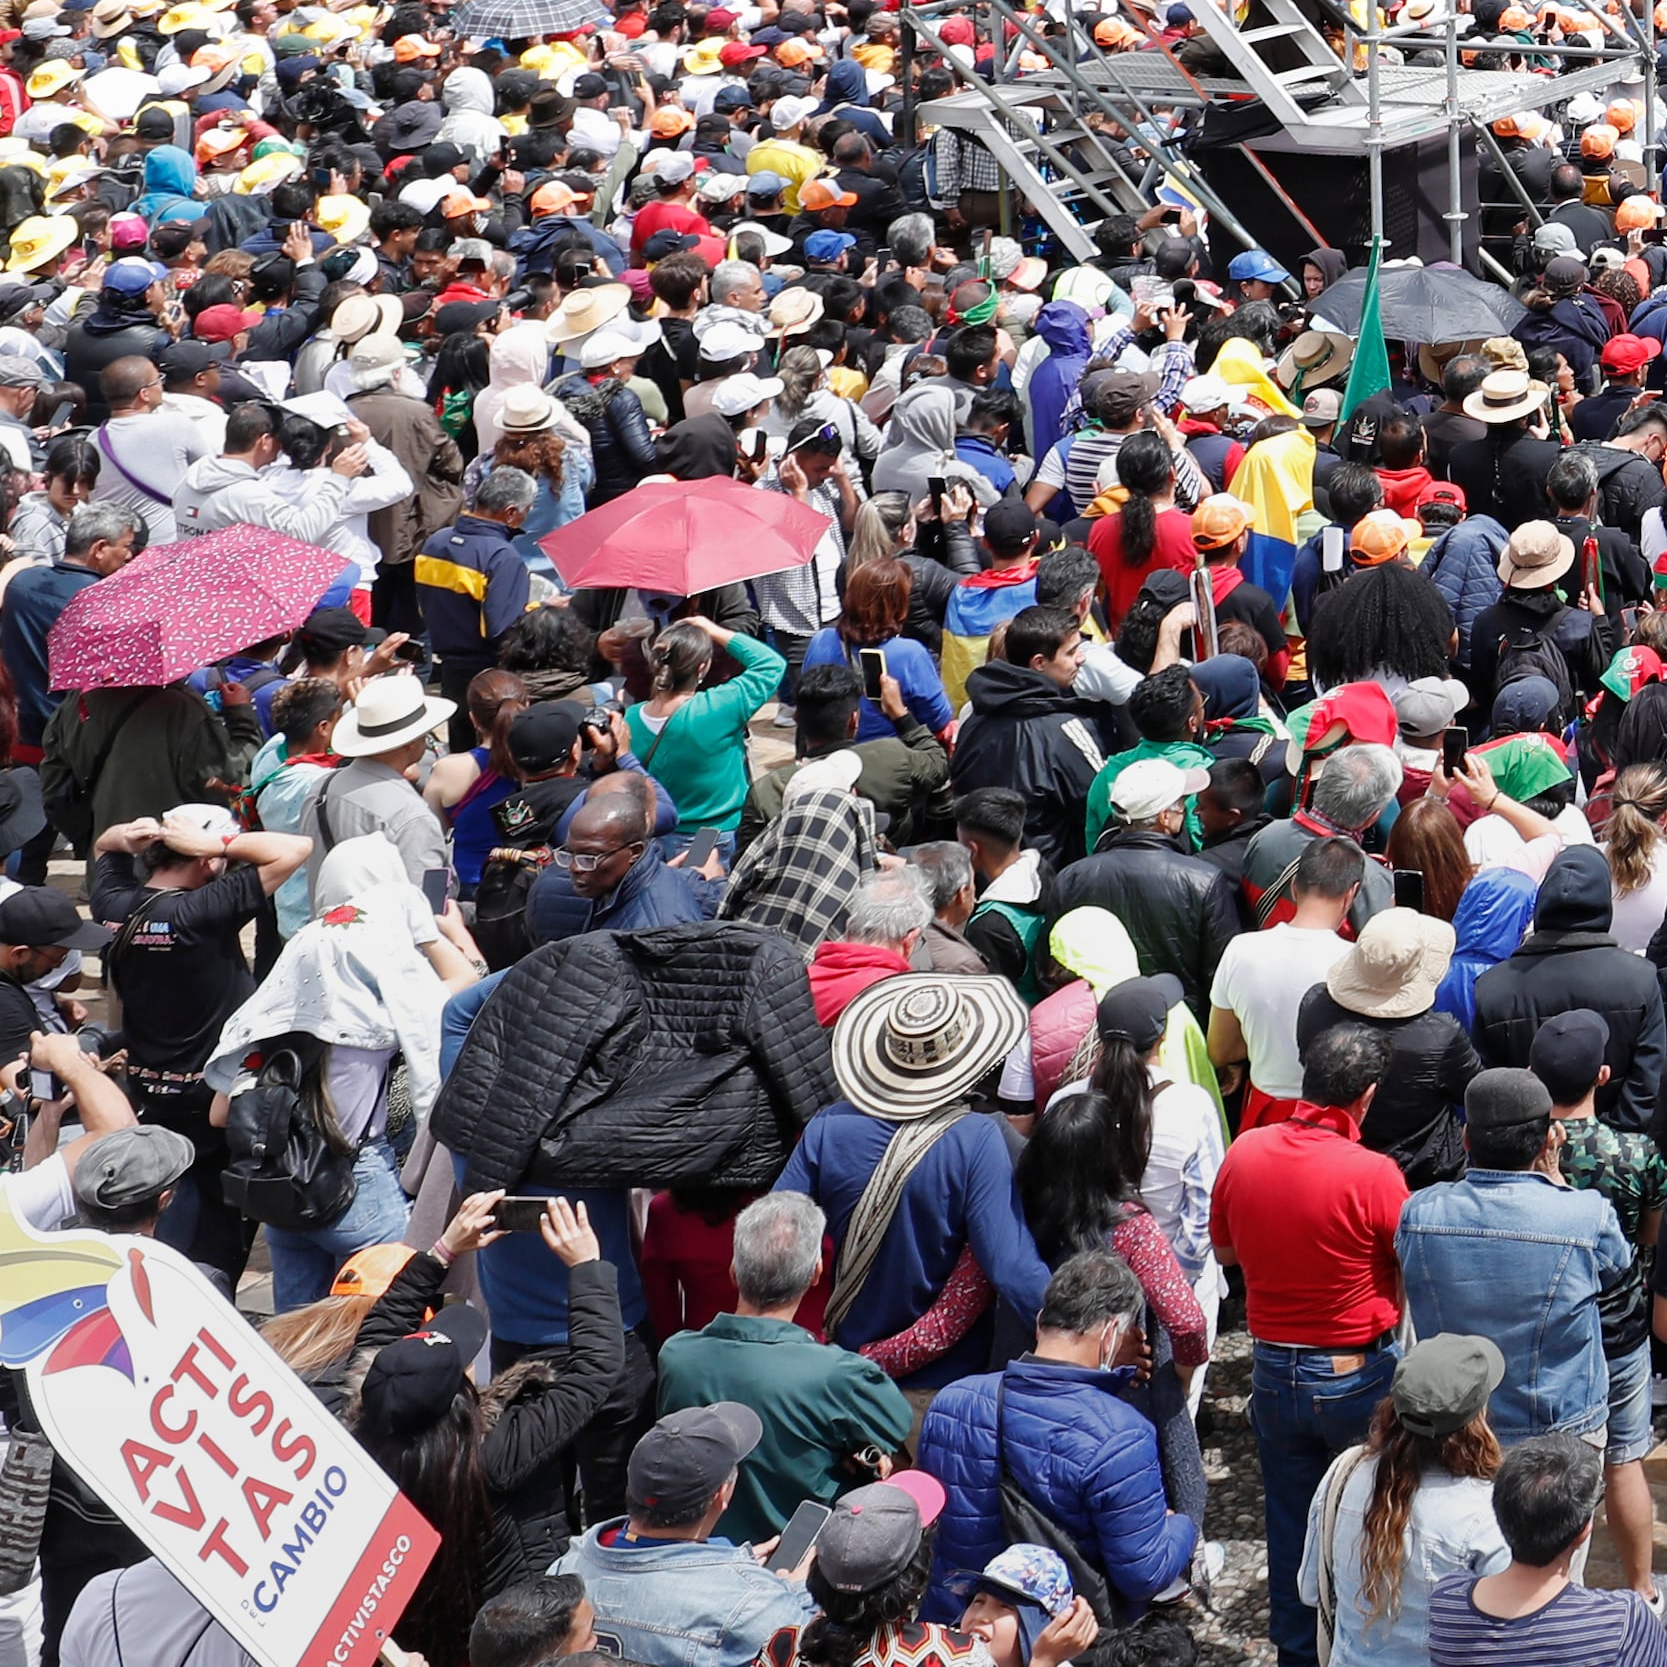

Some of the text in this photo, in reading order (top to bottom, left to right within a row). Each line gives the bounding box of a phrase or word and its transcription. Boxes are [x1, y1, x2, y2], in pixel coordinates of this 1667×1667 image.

[121, 1327, 236, 1502] ACTI
[151, 1373, 274, 1532] VIS
[199, 1418, 317, 1577] TAS
[240, 1464, 348, 1628] DEL CAMBIO
